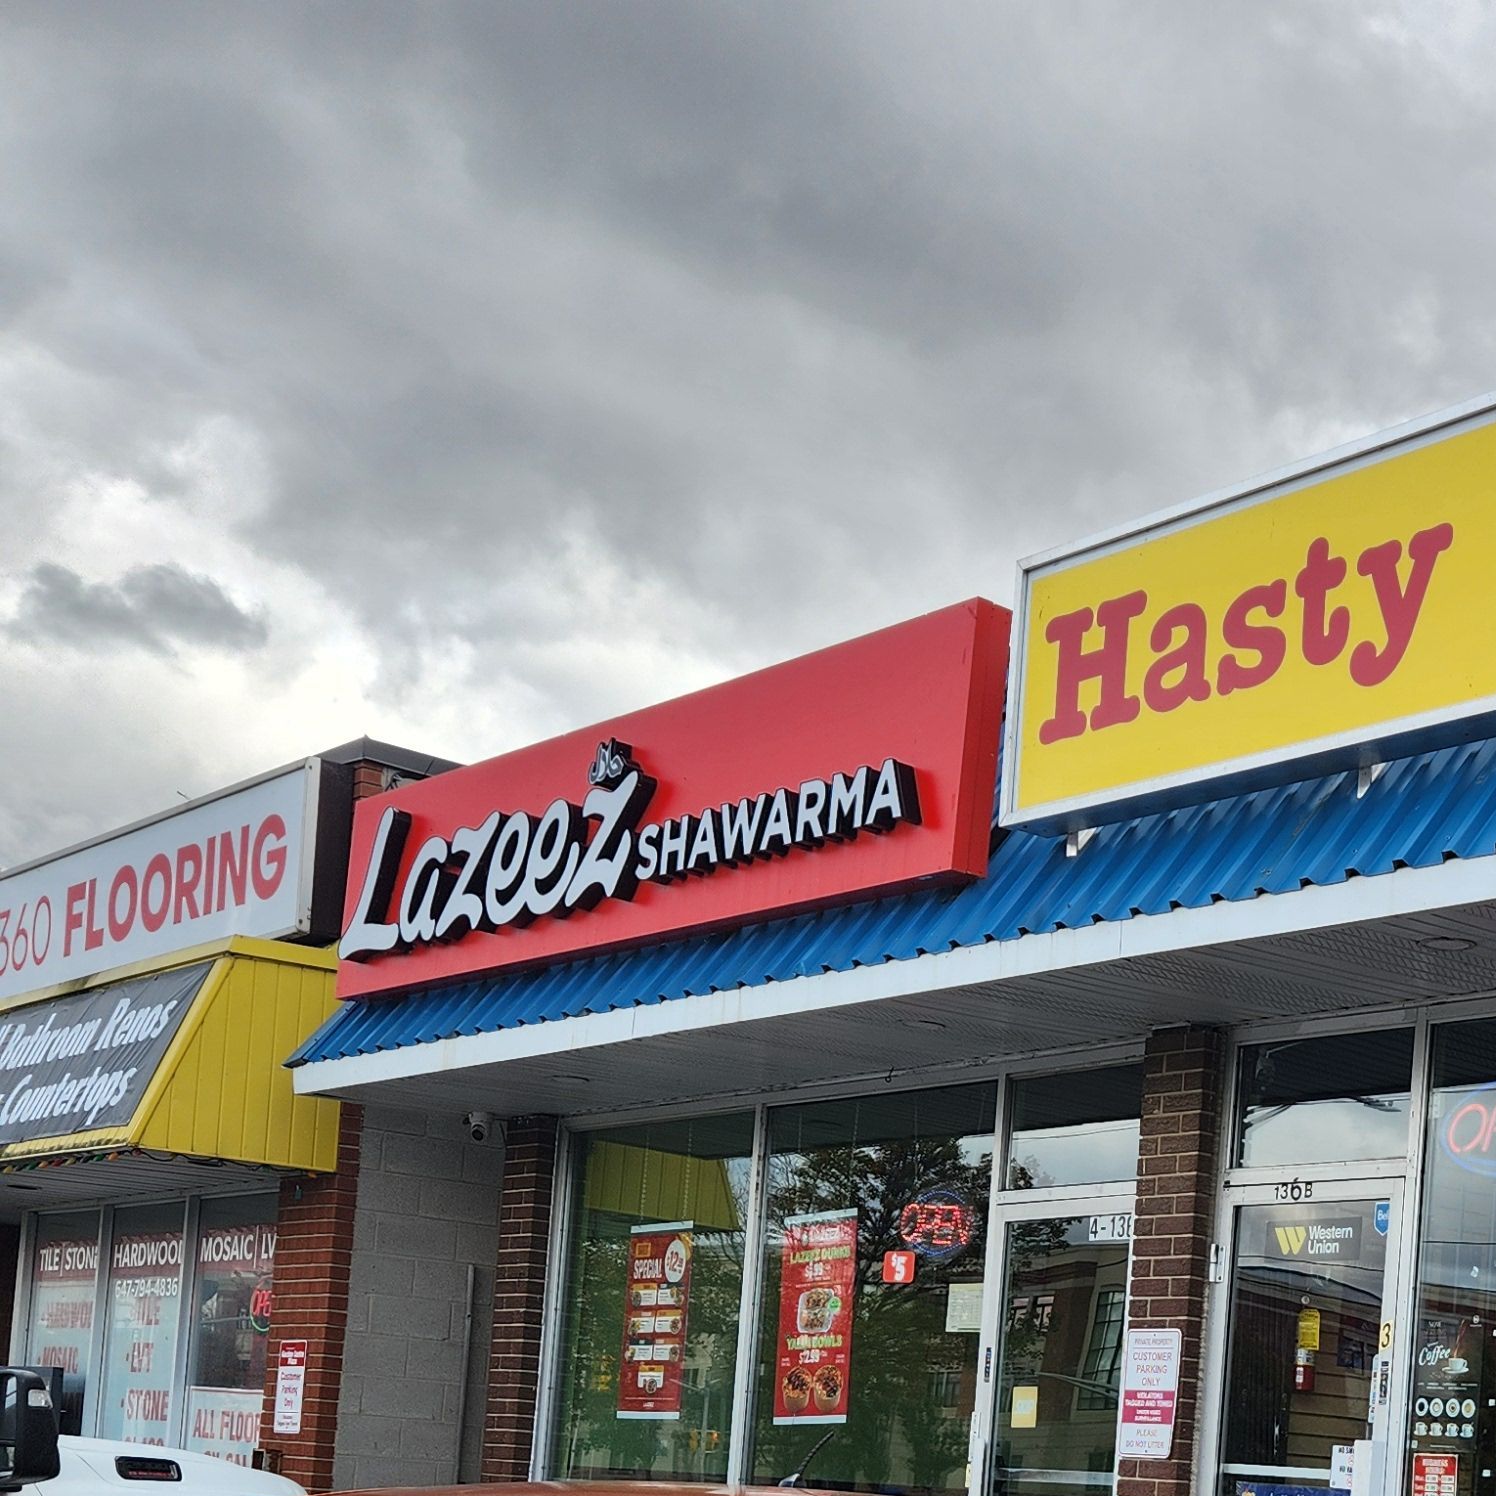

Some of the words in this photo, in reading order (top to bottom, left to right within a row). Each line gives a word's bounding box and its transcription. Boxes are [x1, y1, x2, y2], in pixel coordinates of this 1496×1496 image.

[1038, 522, 1454, 746] Hasty
[634, 757, 905, 882] SHAWARMA
[0, 895, 52, 978] 360
[63, 813, 288, 958] FLOORING
[94, 998, 178, 1051] Renos
[0, 1066, 138, 1127] Countertops
[1274, 1177, 1313, 1201] 136B
[901, 1203, 972, 1246] OPEN
[1308, 1225, 1353, 1240] Western
[40, 1248, 61, 1272] TILE
[200, 1233, 255, 1263] MOSAIC
[1307, 1241, 1340, 1255] Union
[633, 1258, 663, 1280] SPECIAL
[891, 1252, 908, 1282] $5
[115, 1277, 179, 1299] 647-794-4836
[1381, 1322, 1391, 1349] 3
[1133, 1351, 1172, 1361] CUSTOMER
[1418, 1343, 1451, 1366] Coffee
[1136, 1365, 1168, 1375] PARKING
[1141, 1378, 1160, 1387] ONLY
[126, 1389, 170, 1422] STONE
[192, 1408, 215, 1440] ALL
[1125, 1440, 1135, 1448] DO
